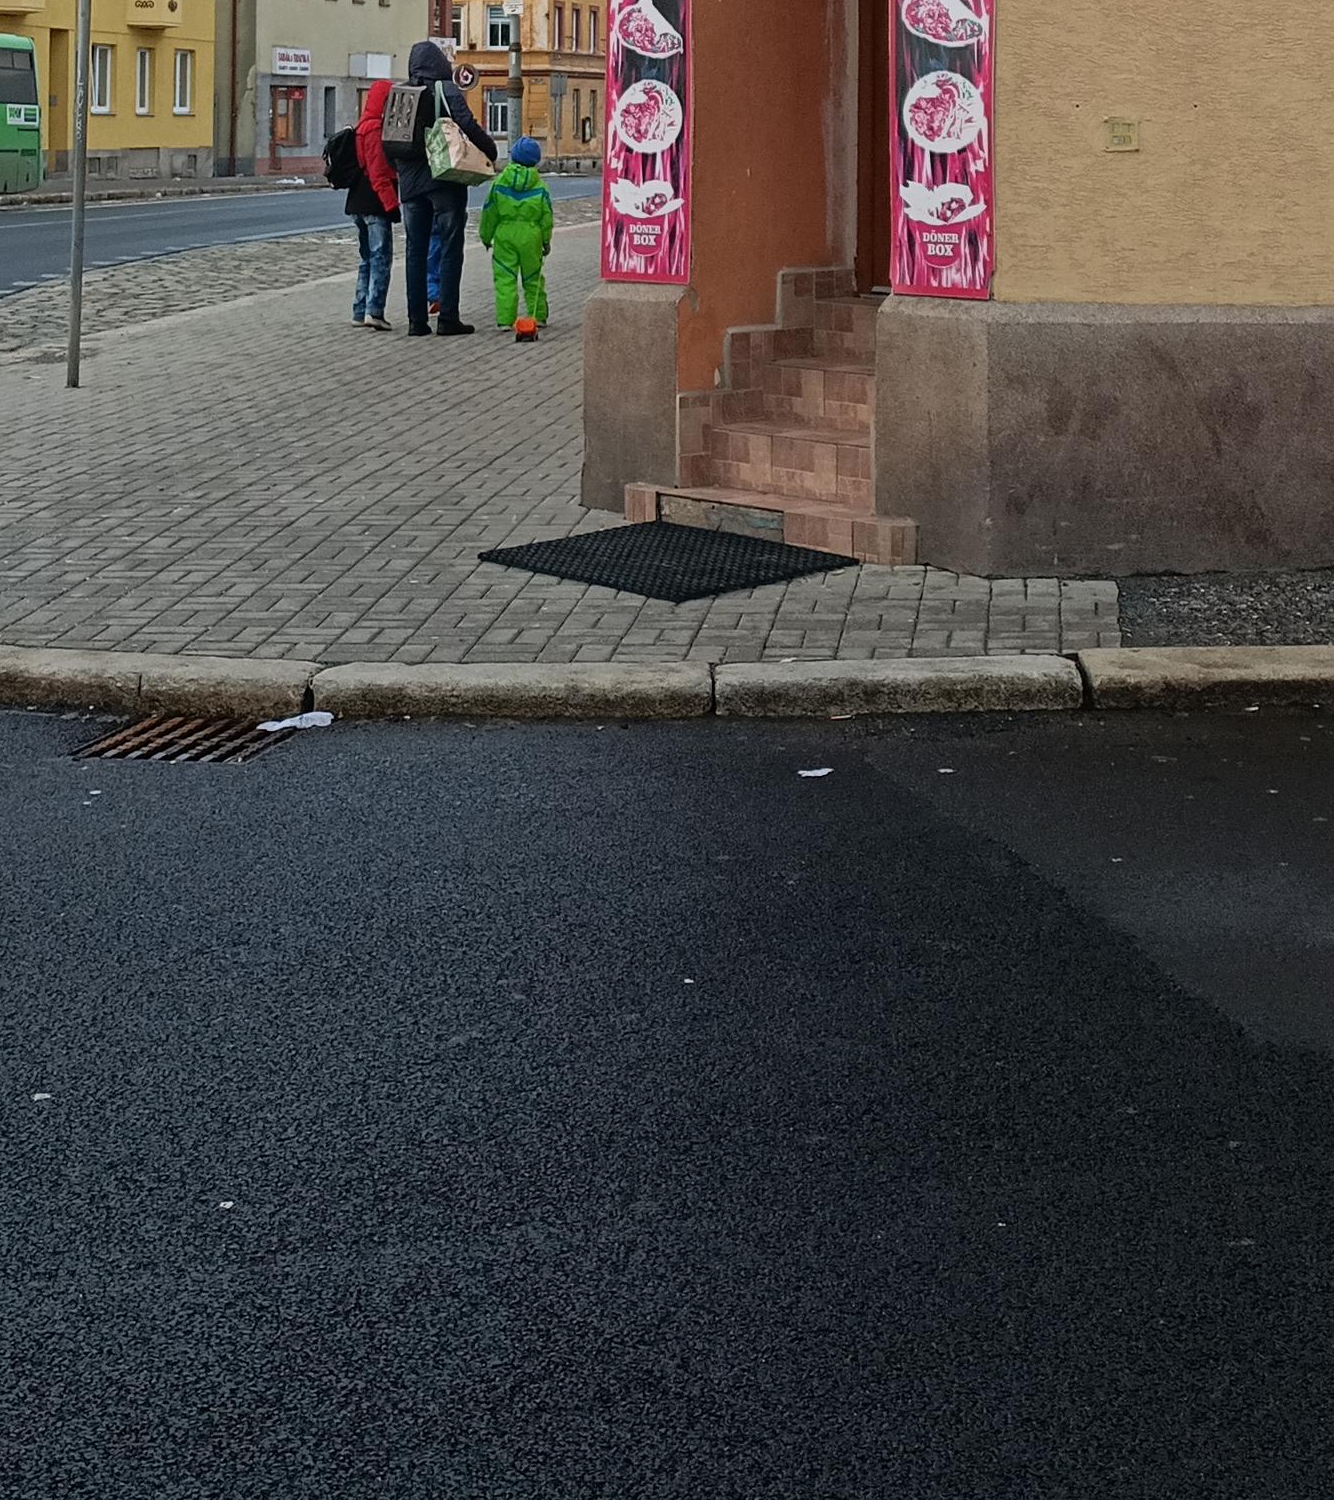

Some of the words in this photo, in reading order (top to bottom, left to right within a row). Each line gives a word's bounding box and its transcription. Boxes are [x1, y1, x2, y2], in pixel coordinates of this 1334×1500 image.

[629, 221, 662, 235] DÖNER
[633, 234, 657, 246] BOX
[922, 229, 960, 243] DÖNER
[927, 243, 955, 257] BOX
